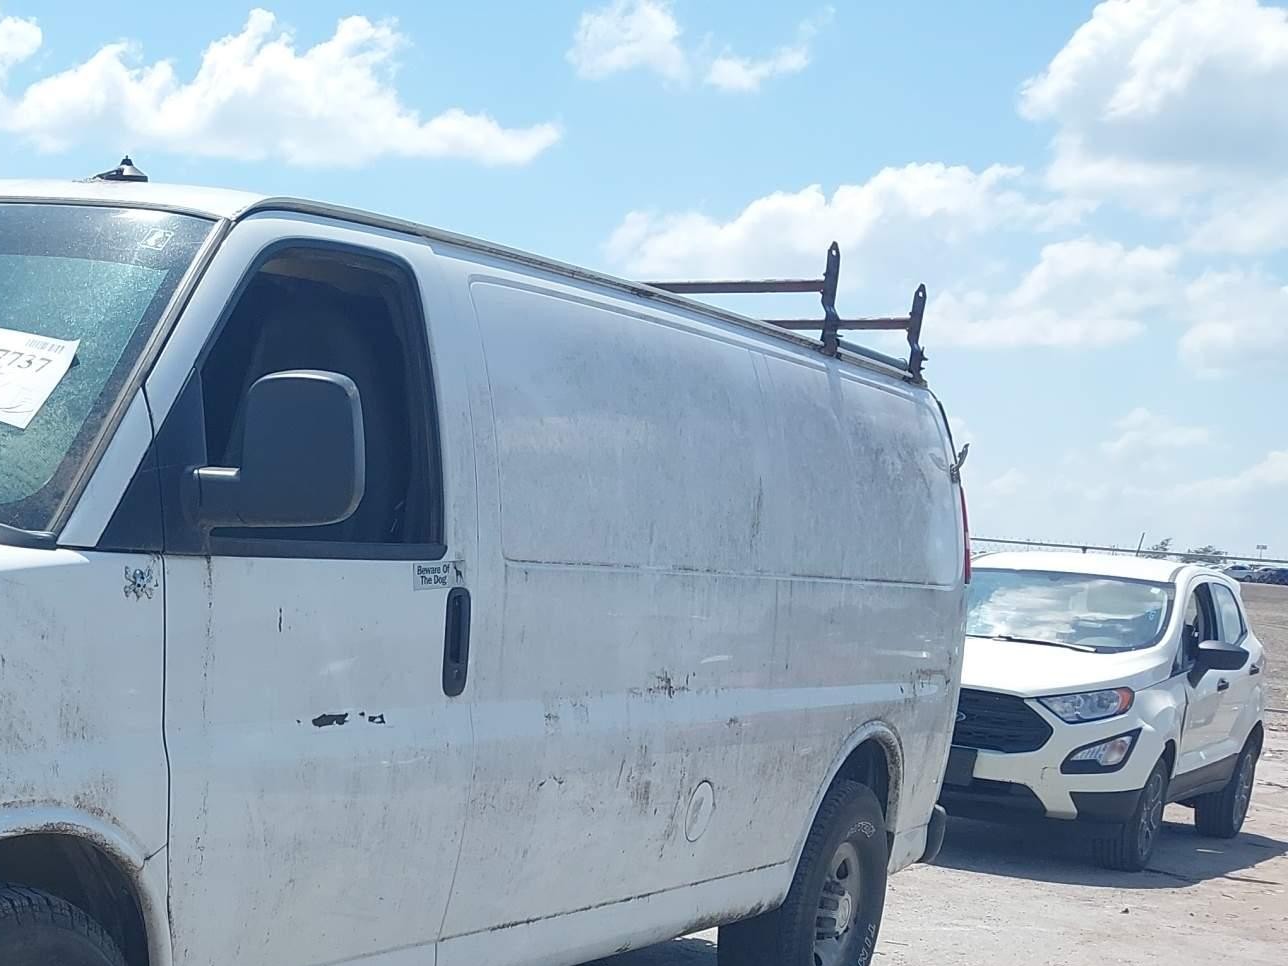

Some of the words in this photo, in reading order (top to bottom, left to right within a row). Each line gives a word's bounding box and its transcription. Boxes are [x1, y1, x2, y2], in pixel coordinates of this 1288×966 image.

[416, 565, 441, 576] Beware
[442, 563, 450, 574] Of
[420, 575, 433, 585] The
[433, 574, 447, 586] Dog
